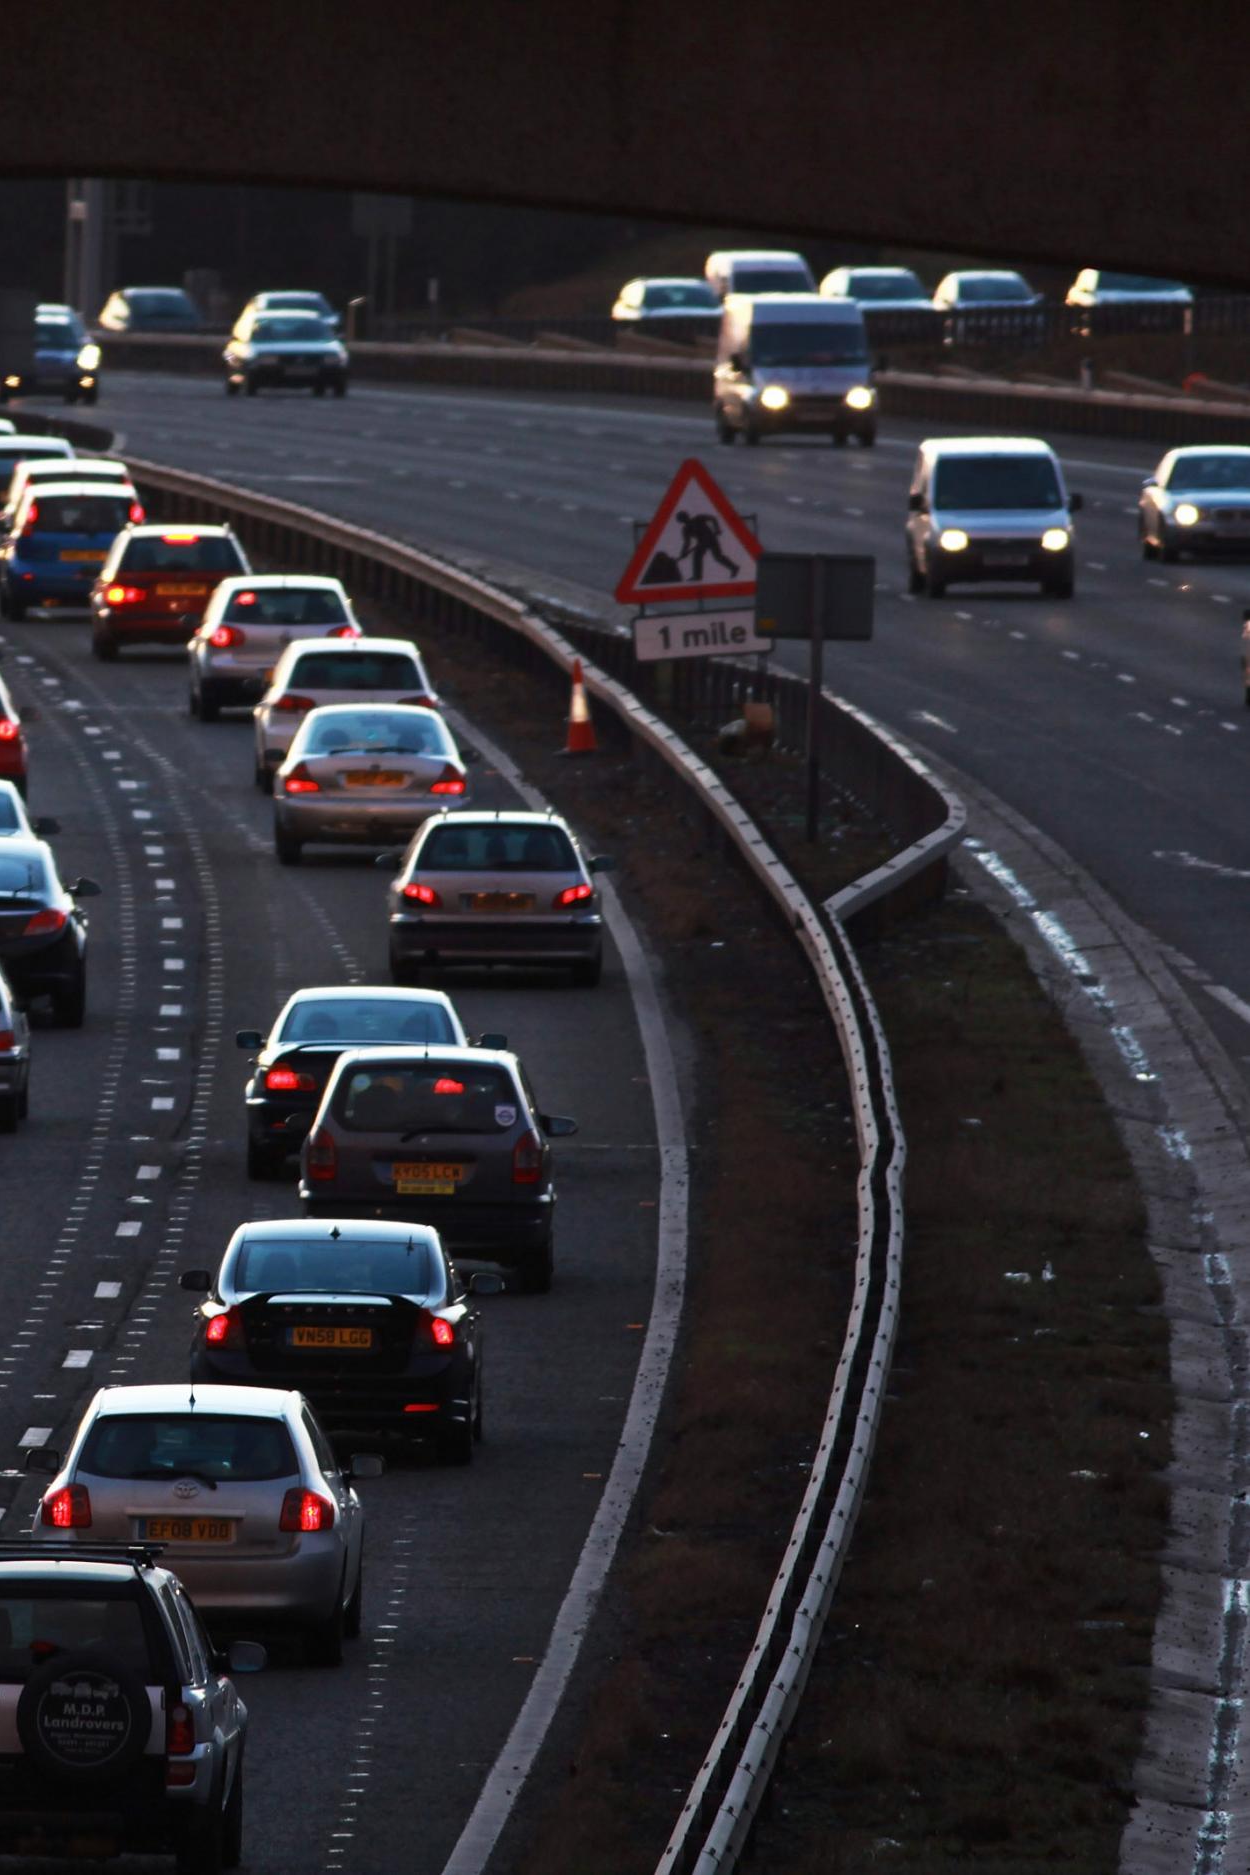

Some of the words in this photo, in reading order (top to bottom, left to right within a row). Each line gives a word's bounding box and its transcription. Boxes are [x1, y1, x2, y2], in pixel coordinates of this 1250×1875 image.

[659, 625, 670, 649] 1
[683, 621, 747, 647] mile
[44, 1714, 125, 1731] Landrovers
